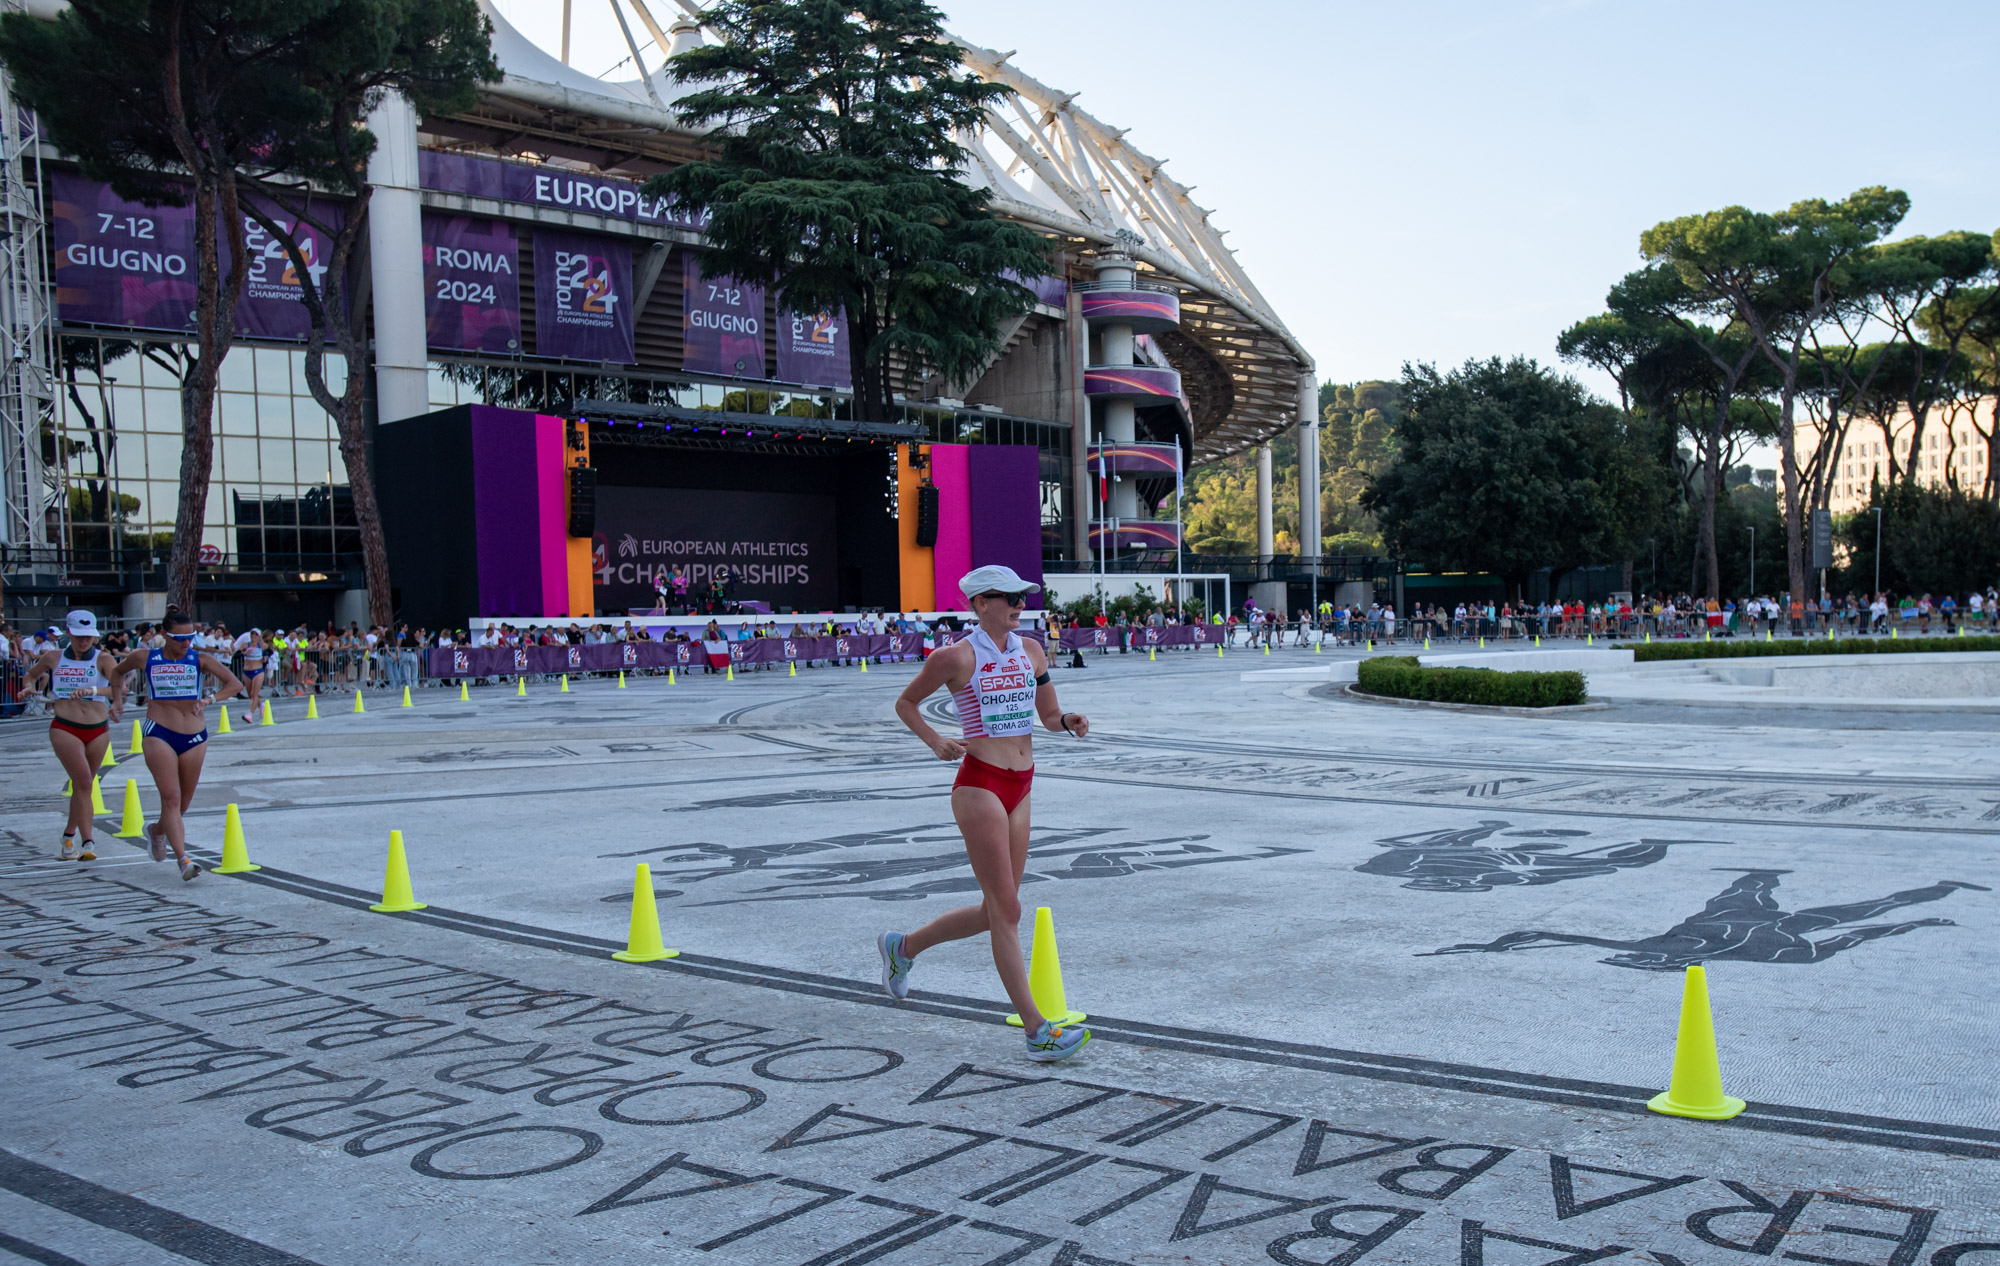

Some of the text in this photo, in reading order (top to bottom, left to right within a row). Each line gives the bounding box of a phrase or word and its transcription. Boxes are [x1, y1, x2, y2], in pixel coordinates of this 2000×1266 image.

[97, 212, 155, 239] 7-12
[67, 243, 187, 275] GIUGNO
[555, 251, 572, 310] roma
[437, 279, 497, 305] 2024
[708, 285, 741, 306] 7-12
[557, 316, 614, 328] CHAMPIONSHIPS
[690, 309, 758, 335] GIUGNO
[642, 540, 809, 556] EUROPEAN ATHLETICS
[56, 668, 85, 676] SPAR
[152, 665, 185, 674] SPAR
[981, 674, 1025, 691] SPAR
[981, 690, 1034, 705] CHOJECKA
[1006, 703, 1019, 712] 125
[991, 719, 1031, 731] ROMA 2024
